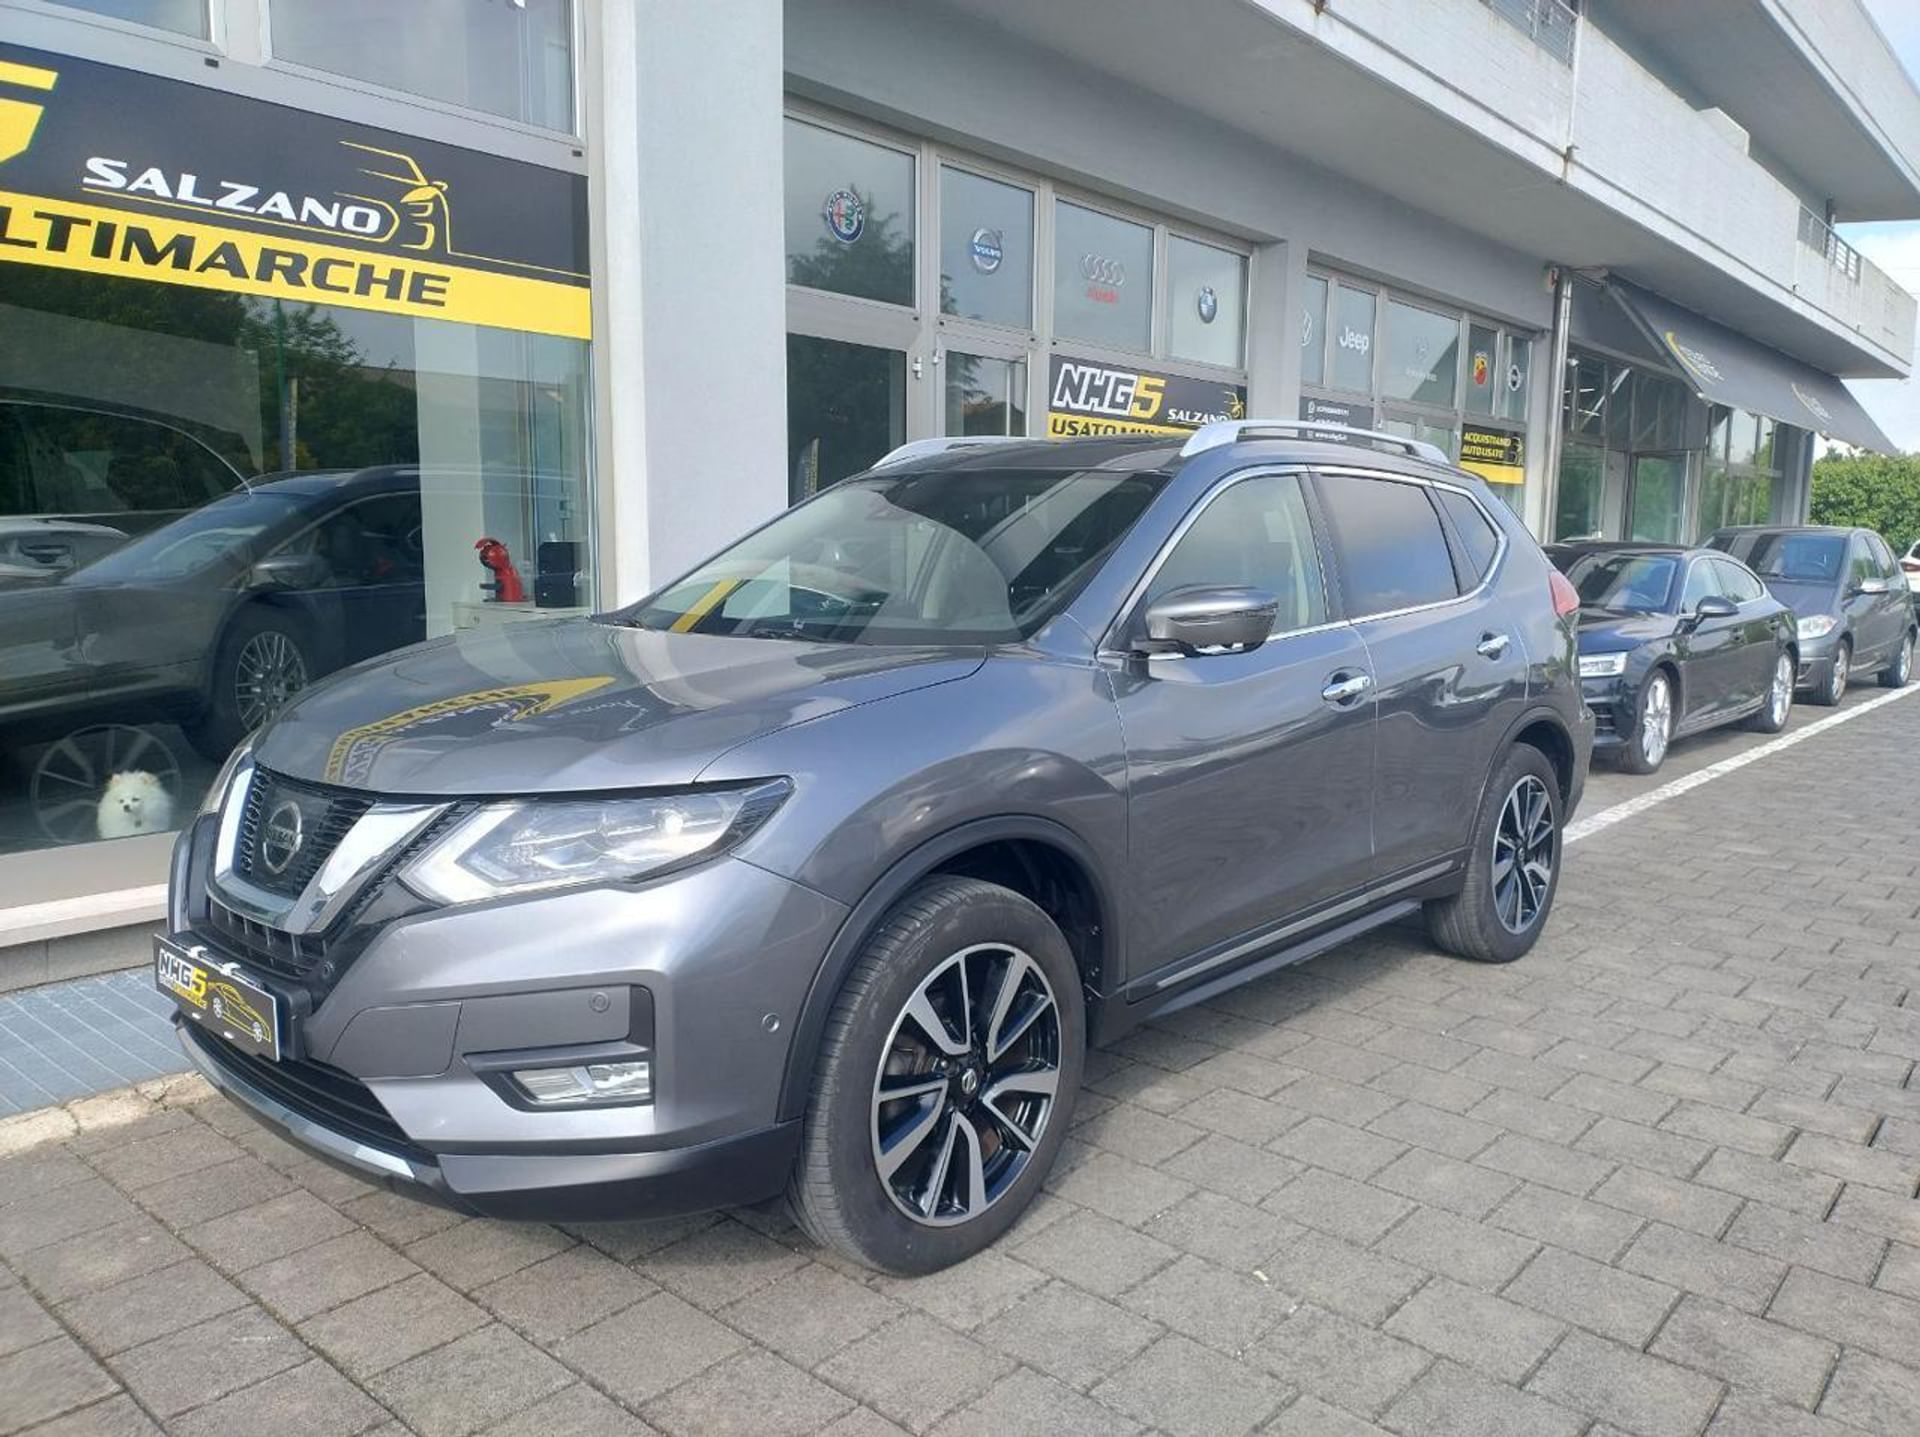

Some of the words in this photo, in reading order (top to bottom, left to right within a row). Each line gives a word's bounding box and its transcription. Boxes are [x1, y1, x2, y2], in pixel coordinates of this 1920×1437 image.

[83, 156, 381, 234] SALZANO
[1340, 326, 1369, 355] Jeep
[1052, 362, 1166, 419] NHG5
[159, 948, 208, 998] NHG5
